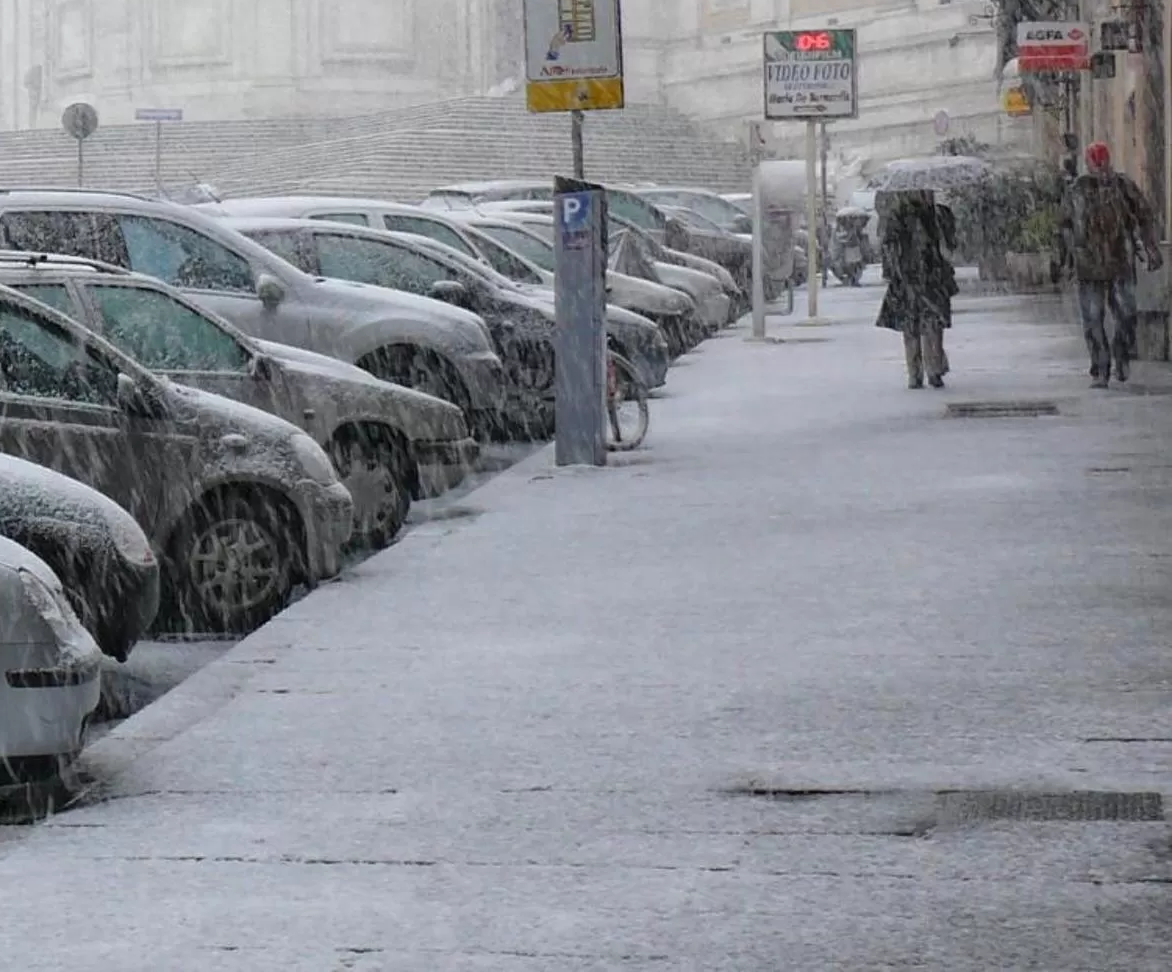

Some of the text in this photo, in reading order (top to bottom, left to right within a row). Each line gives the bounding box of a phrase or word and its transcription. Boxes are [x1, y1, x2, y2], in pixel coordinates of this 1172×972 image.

[768, 63, 850, 82] VIDEO FOTO
[564, 198, 581, 224] P
